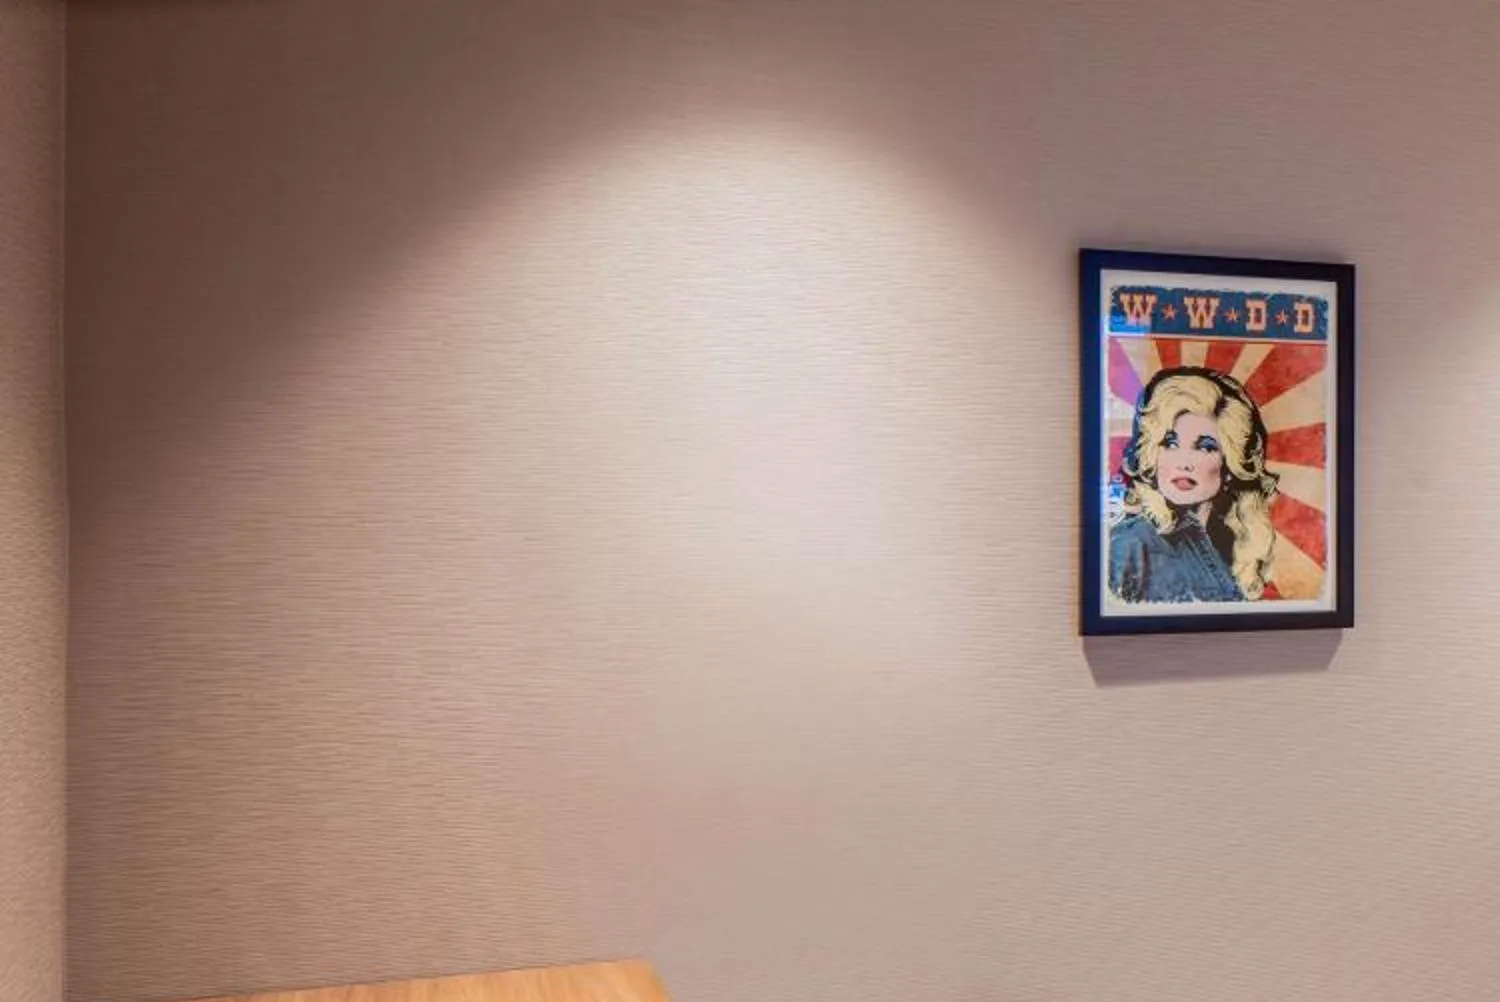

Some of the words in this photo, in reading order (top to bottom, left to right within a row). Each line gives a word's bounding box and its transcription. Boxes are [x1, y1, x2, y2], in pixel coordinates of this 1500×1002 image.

[1119, 293, 1157, 326] W
[1183, 295, 1221, 329] W
[1245, 299, 1267, 332] D
[1293, 301, 1315, 333] D
